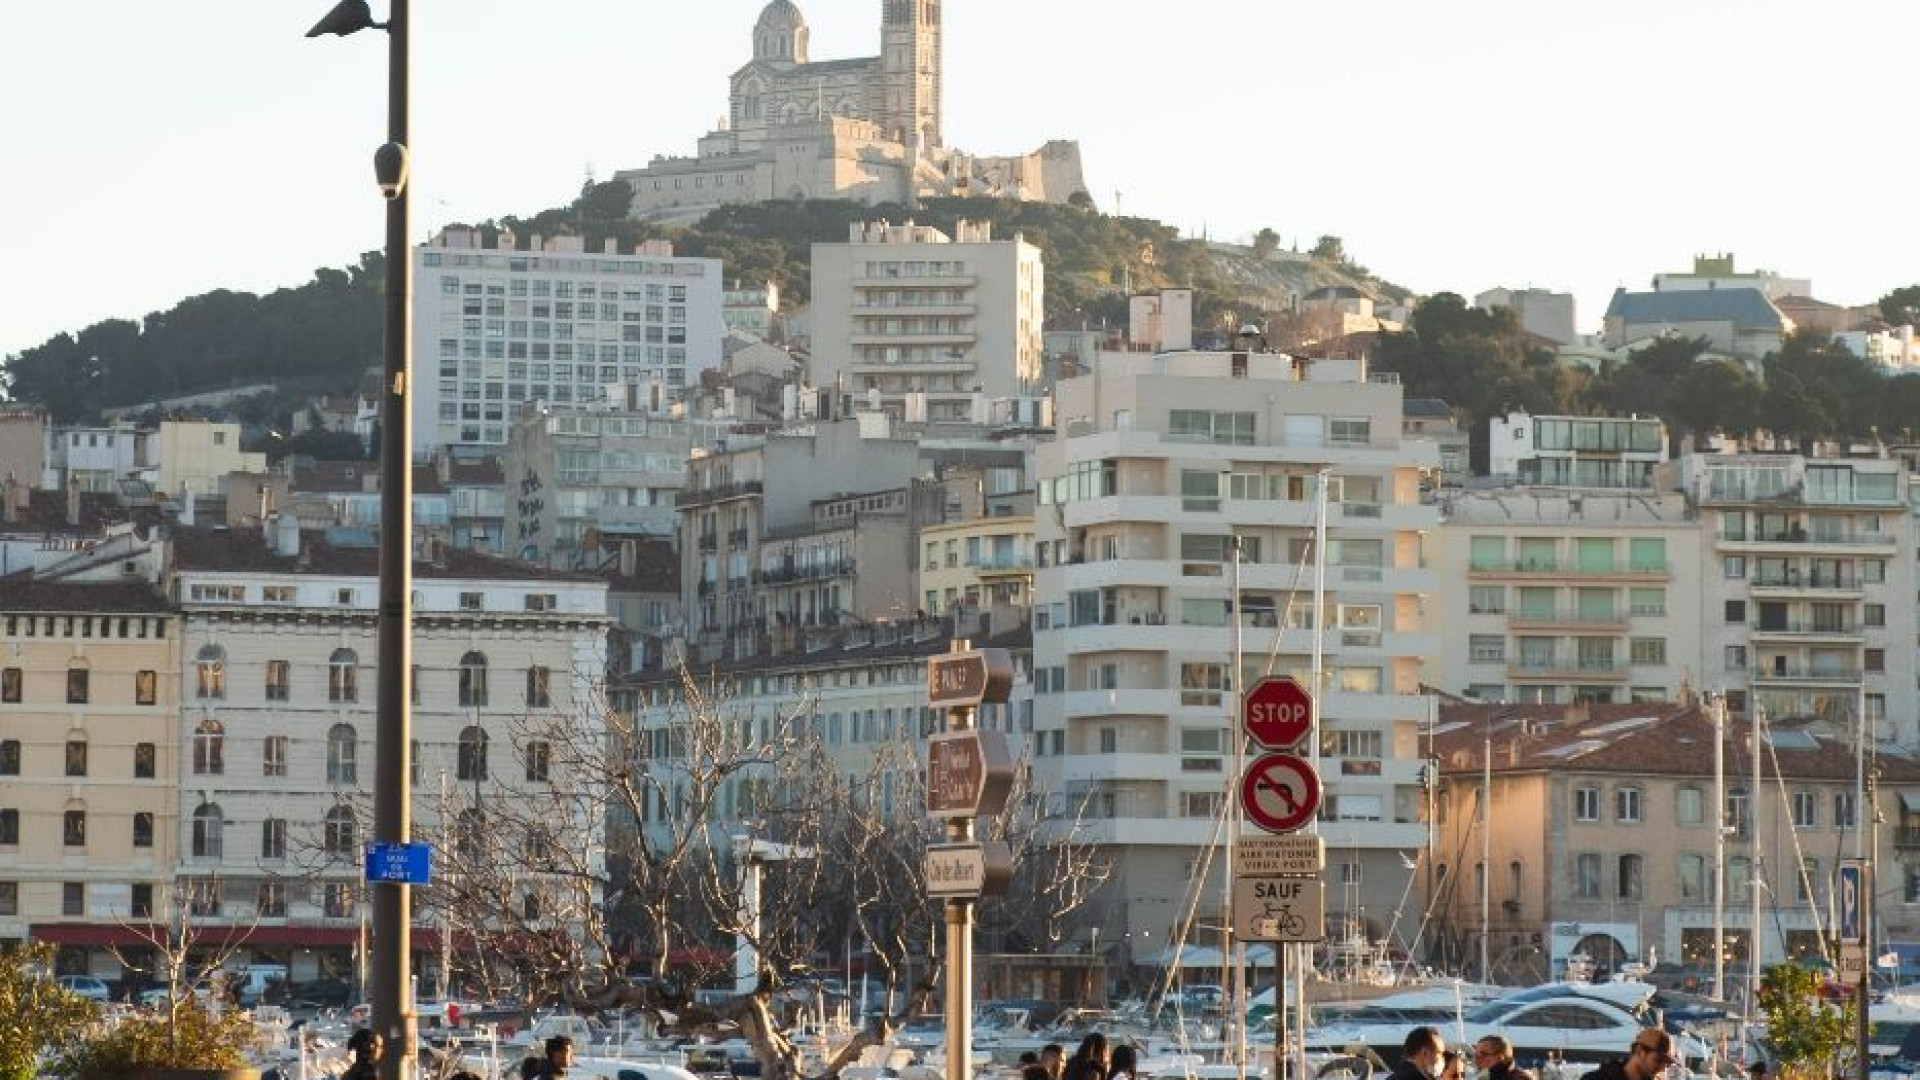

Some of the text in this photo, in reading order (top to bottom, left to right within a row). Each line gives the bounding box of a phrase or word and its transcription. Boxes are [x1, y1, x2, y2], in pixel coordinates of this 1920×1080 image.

[1251, 703, 1306, 723] STOP
[1239, 850, 1262, 859] AIRE
[1244, 861, 1313, 869] VIEUX PORT
[1254, 882, 1302, 898] SAUF
